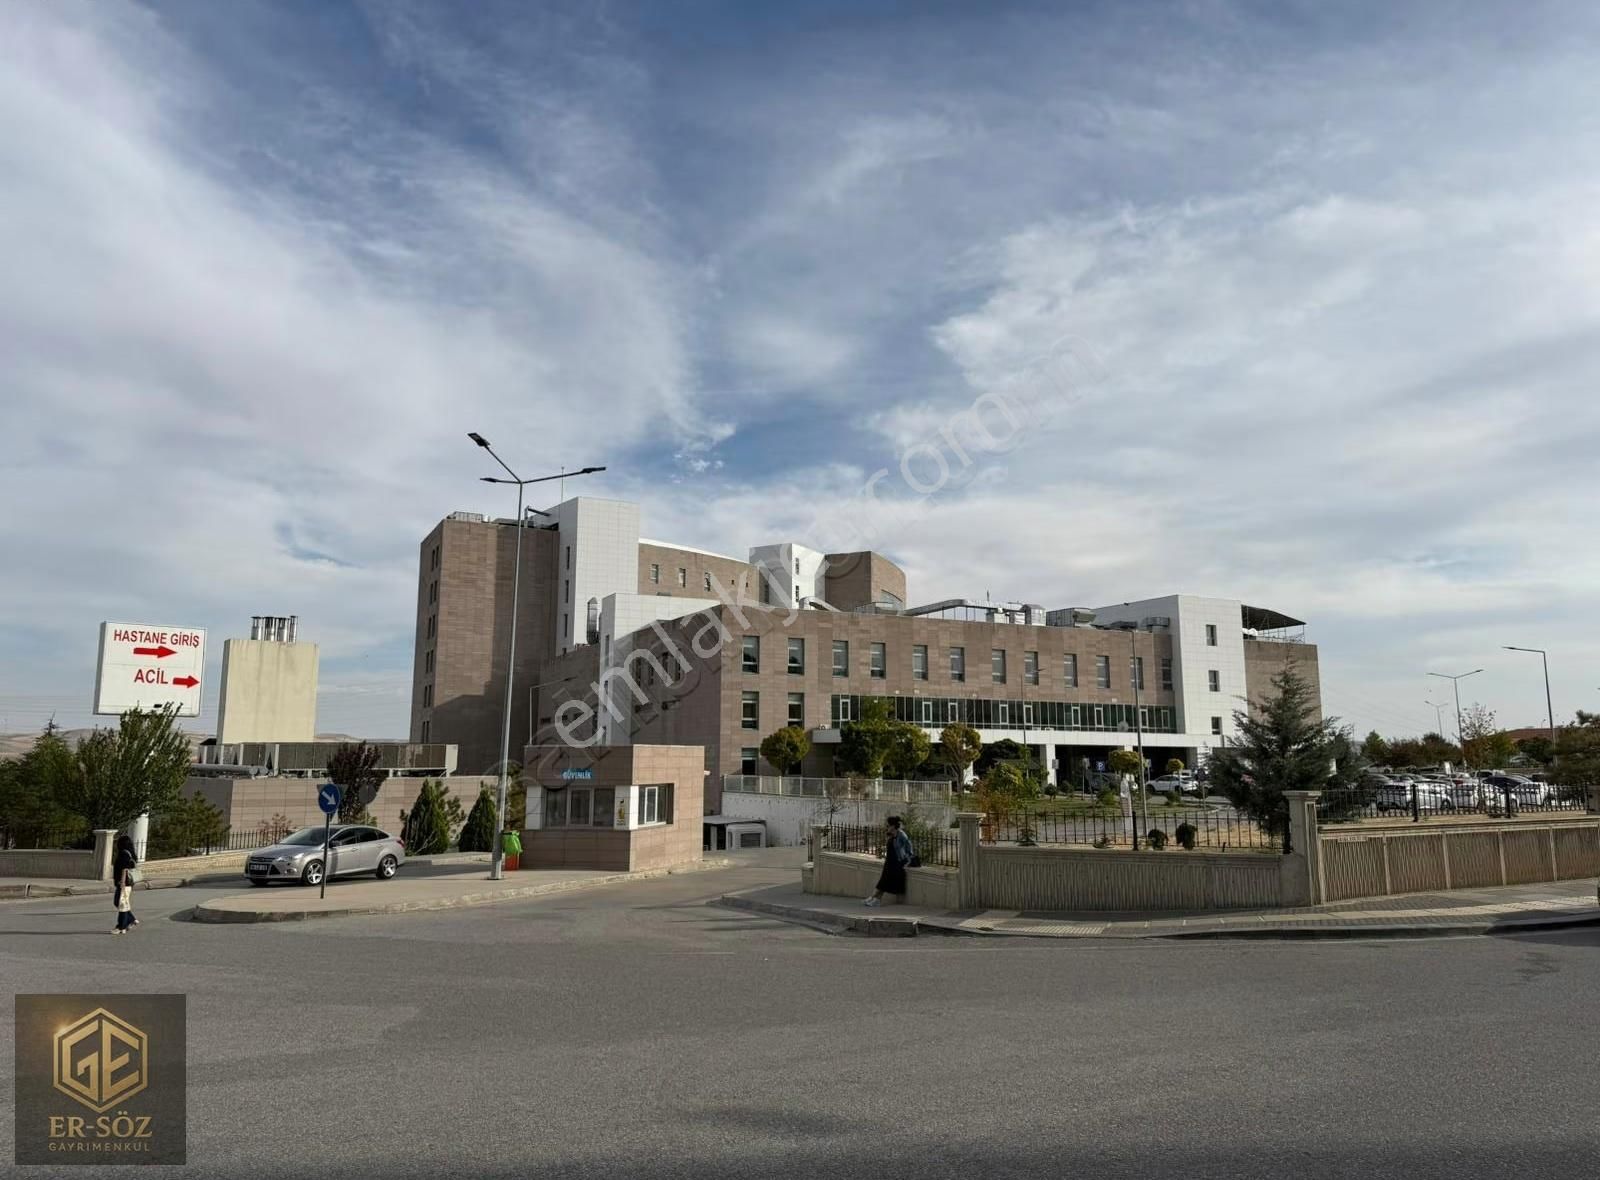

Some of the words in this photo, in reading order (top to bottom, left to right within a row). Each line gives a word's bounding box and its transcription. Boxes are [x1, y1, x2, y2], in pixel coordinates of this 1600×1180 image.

[113, 629, 168, 644] HASTANE
[170, 632, 200, 648] GİRİŞ
[134, 668, 169, 685] ACİL
